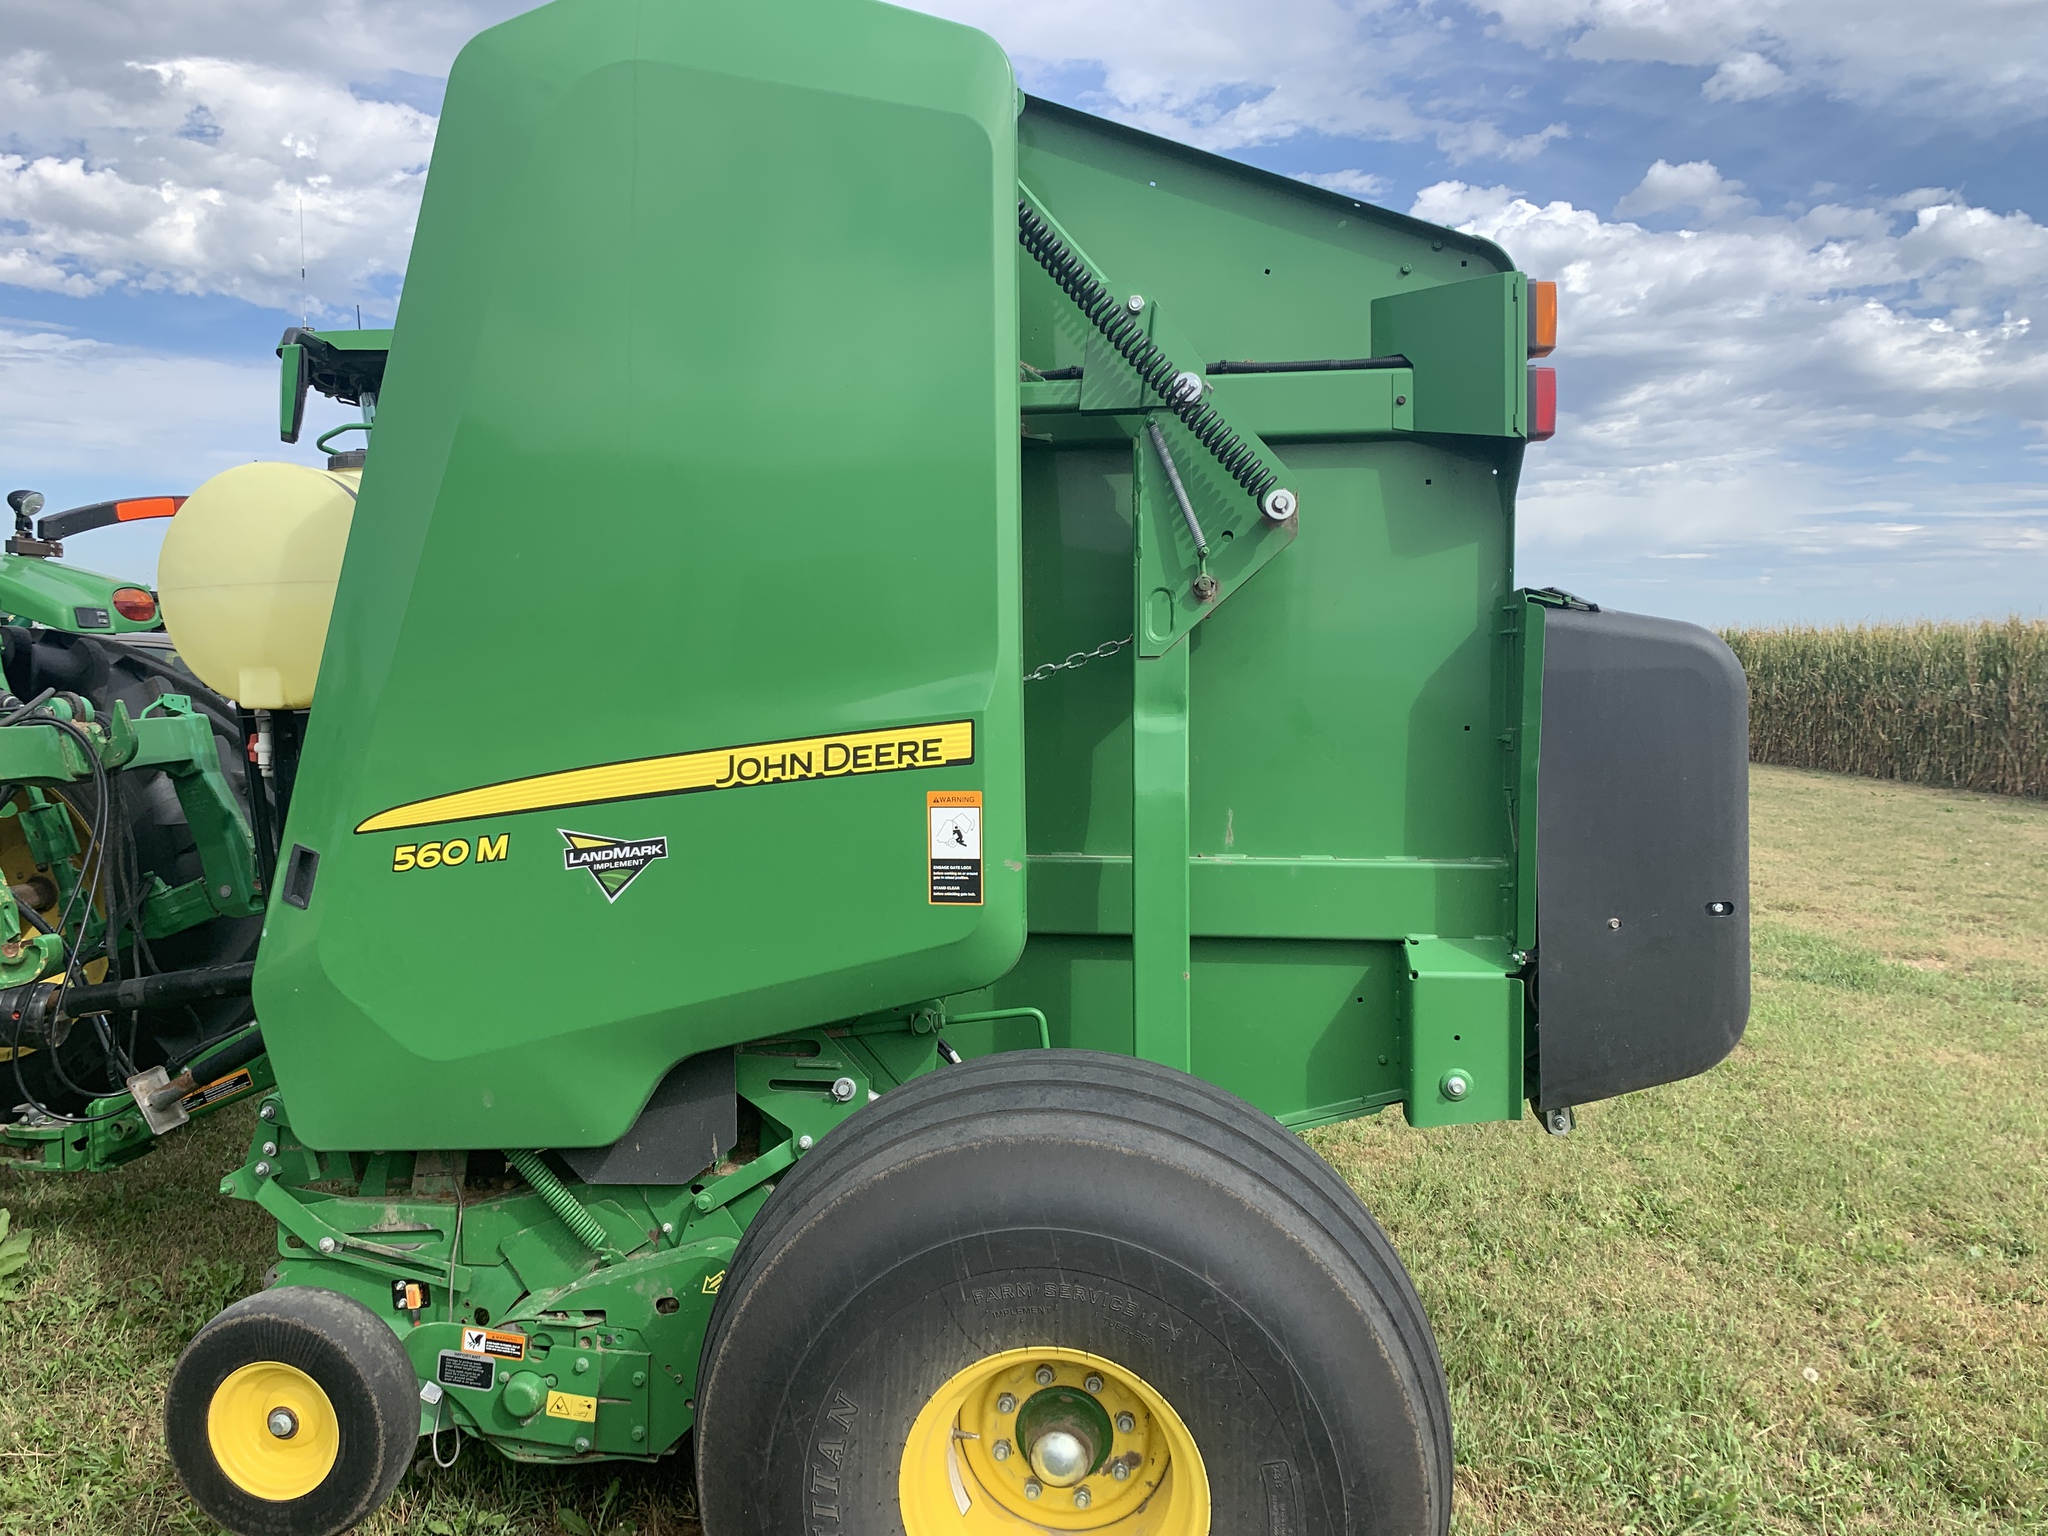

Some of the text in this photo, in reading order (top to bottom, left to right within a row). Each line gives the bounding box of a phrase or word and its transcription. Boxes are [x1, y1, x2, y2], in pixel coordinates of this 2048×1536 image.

[716, 738, 944, 784] JOHN DEERE
[392, 832, 511, 873] 560 M
[593, 858, 645, 870] IMPLEMENT
[972, 1283, 1032, 1306] FARM
[1044, 1283, 1139, 1318] SERVICE
[992, 1306, 1052, 1319] IMPLEMENT
[1101, 1316, 1154, 1345] TUBELESS
